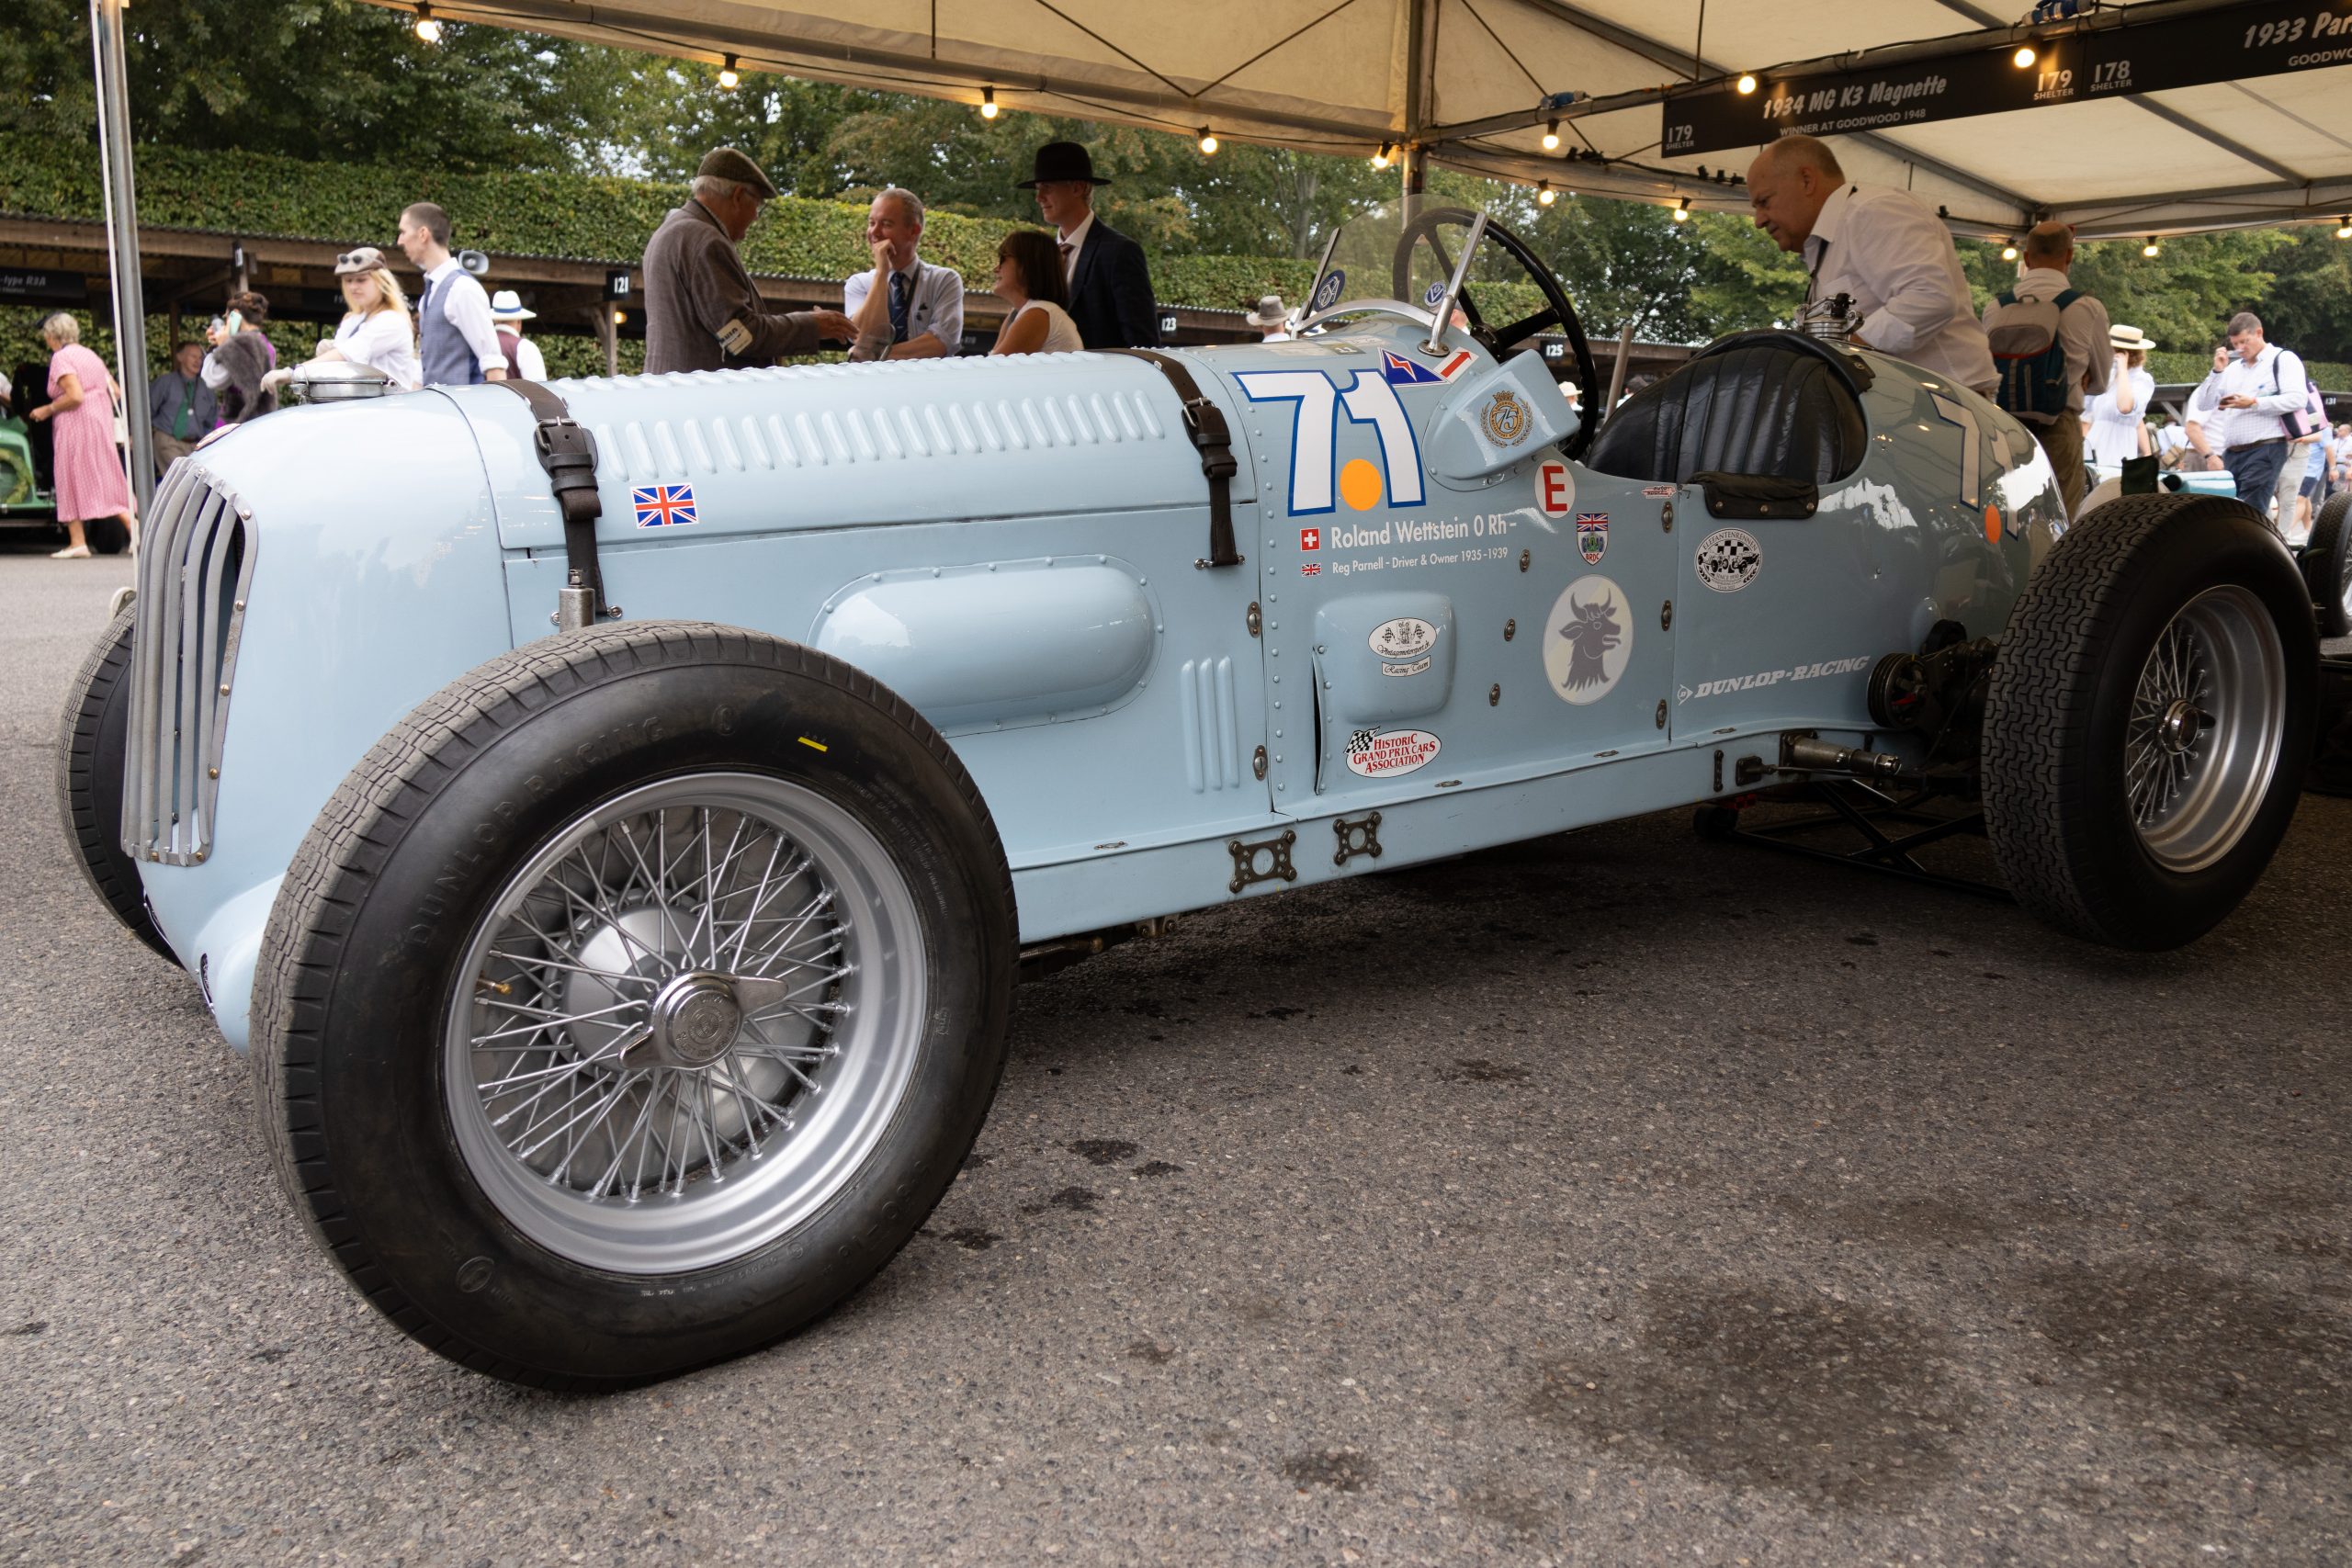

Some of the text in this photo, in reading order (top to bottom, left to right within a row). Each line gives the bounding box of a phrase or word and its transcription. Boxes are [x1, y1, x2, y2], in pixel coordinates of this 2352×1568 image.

[2244, 11, 2352, 49] 1933 Par
[2037, 69, 2073, 92] 179
[2095, 60, 2131, 84] 178
[1763, 74, 1949, 119] 1934 MG K3 Magnette
[2033, 87, 2075, 101] SHELTER
[2090, 78, 2132, 93] SHELTER
[1668, 123, 1693, 143] 179
[1780, 108, 1927, 137] WINNER AT GOODWOOD 1948
[1666, 140, 1695, 151] SHELTER
[614, 276, 629, 294] 121
[1161, 317, 1177, 332] 123
[1545, 344, 1564, 357] 125
[1491, 405, 1521, 434] 75
[1232, 368, 1427, 516] 71
[1542, 465, 1568, 513] E
[1331, 524, 1391, 549] Roland
[1395, 516, 1469, 544] Wettstein
[1702, 531, 1758, 551] ELEFANTENRENNEN
[1332, 561, 1350, 577] Reg
[1352, 557, 1384, 572] Parnell
[1392, 553, 1418, 568] Driver
[1420, 554, 1428, 566] &
[1430, 553, 1459, 565] Owner
[1585, 553, 1600, 562] BRDC
[1694, 656, 1871, 699] DUNLOP-RACING
[1352, 740, 1436, 765] GRAND PRIX CARS
[1374, 733, 1418, 750] HISTORIC
[1364, 752, 1426, 773] ASSOCIATION
